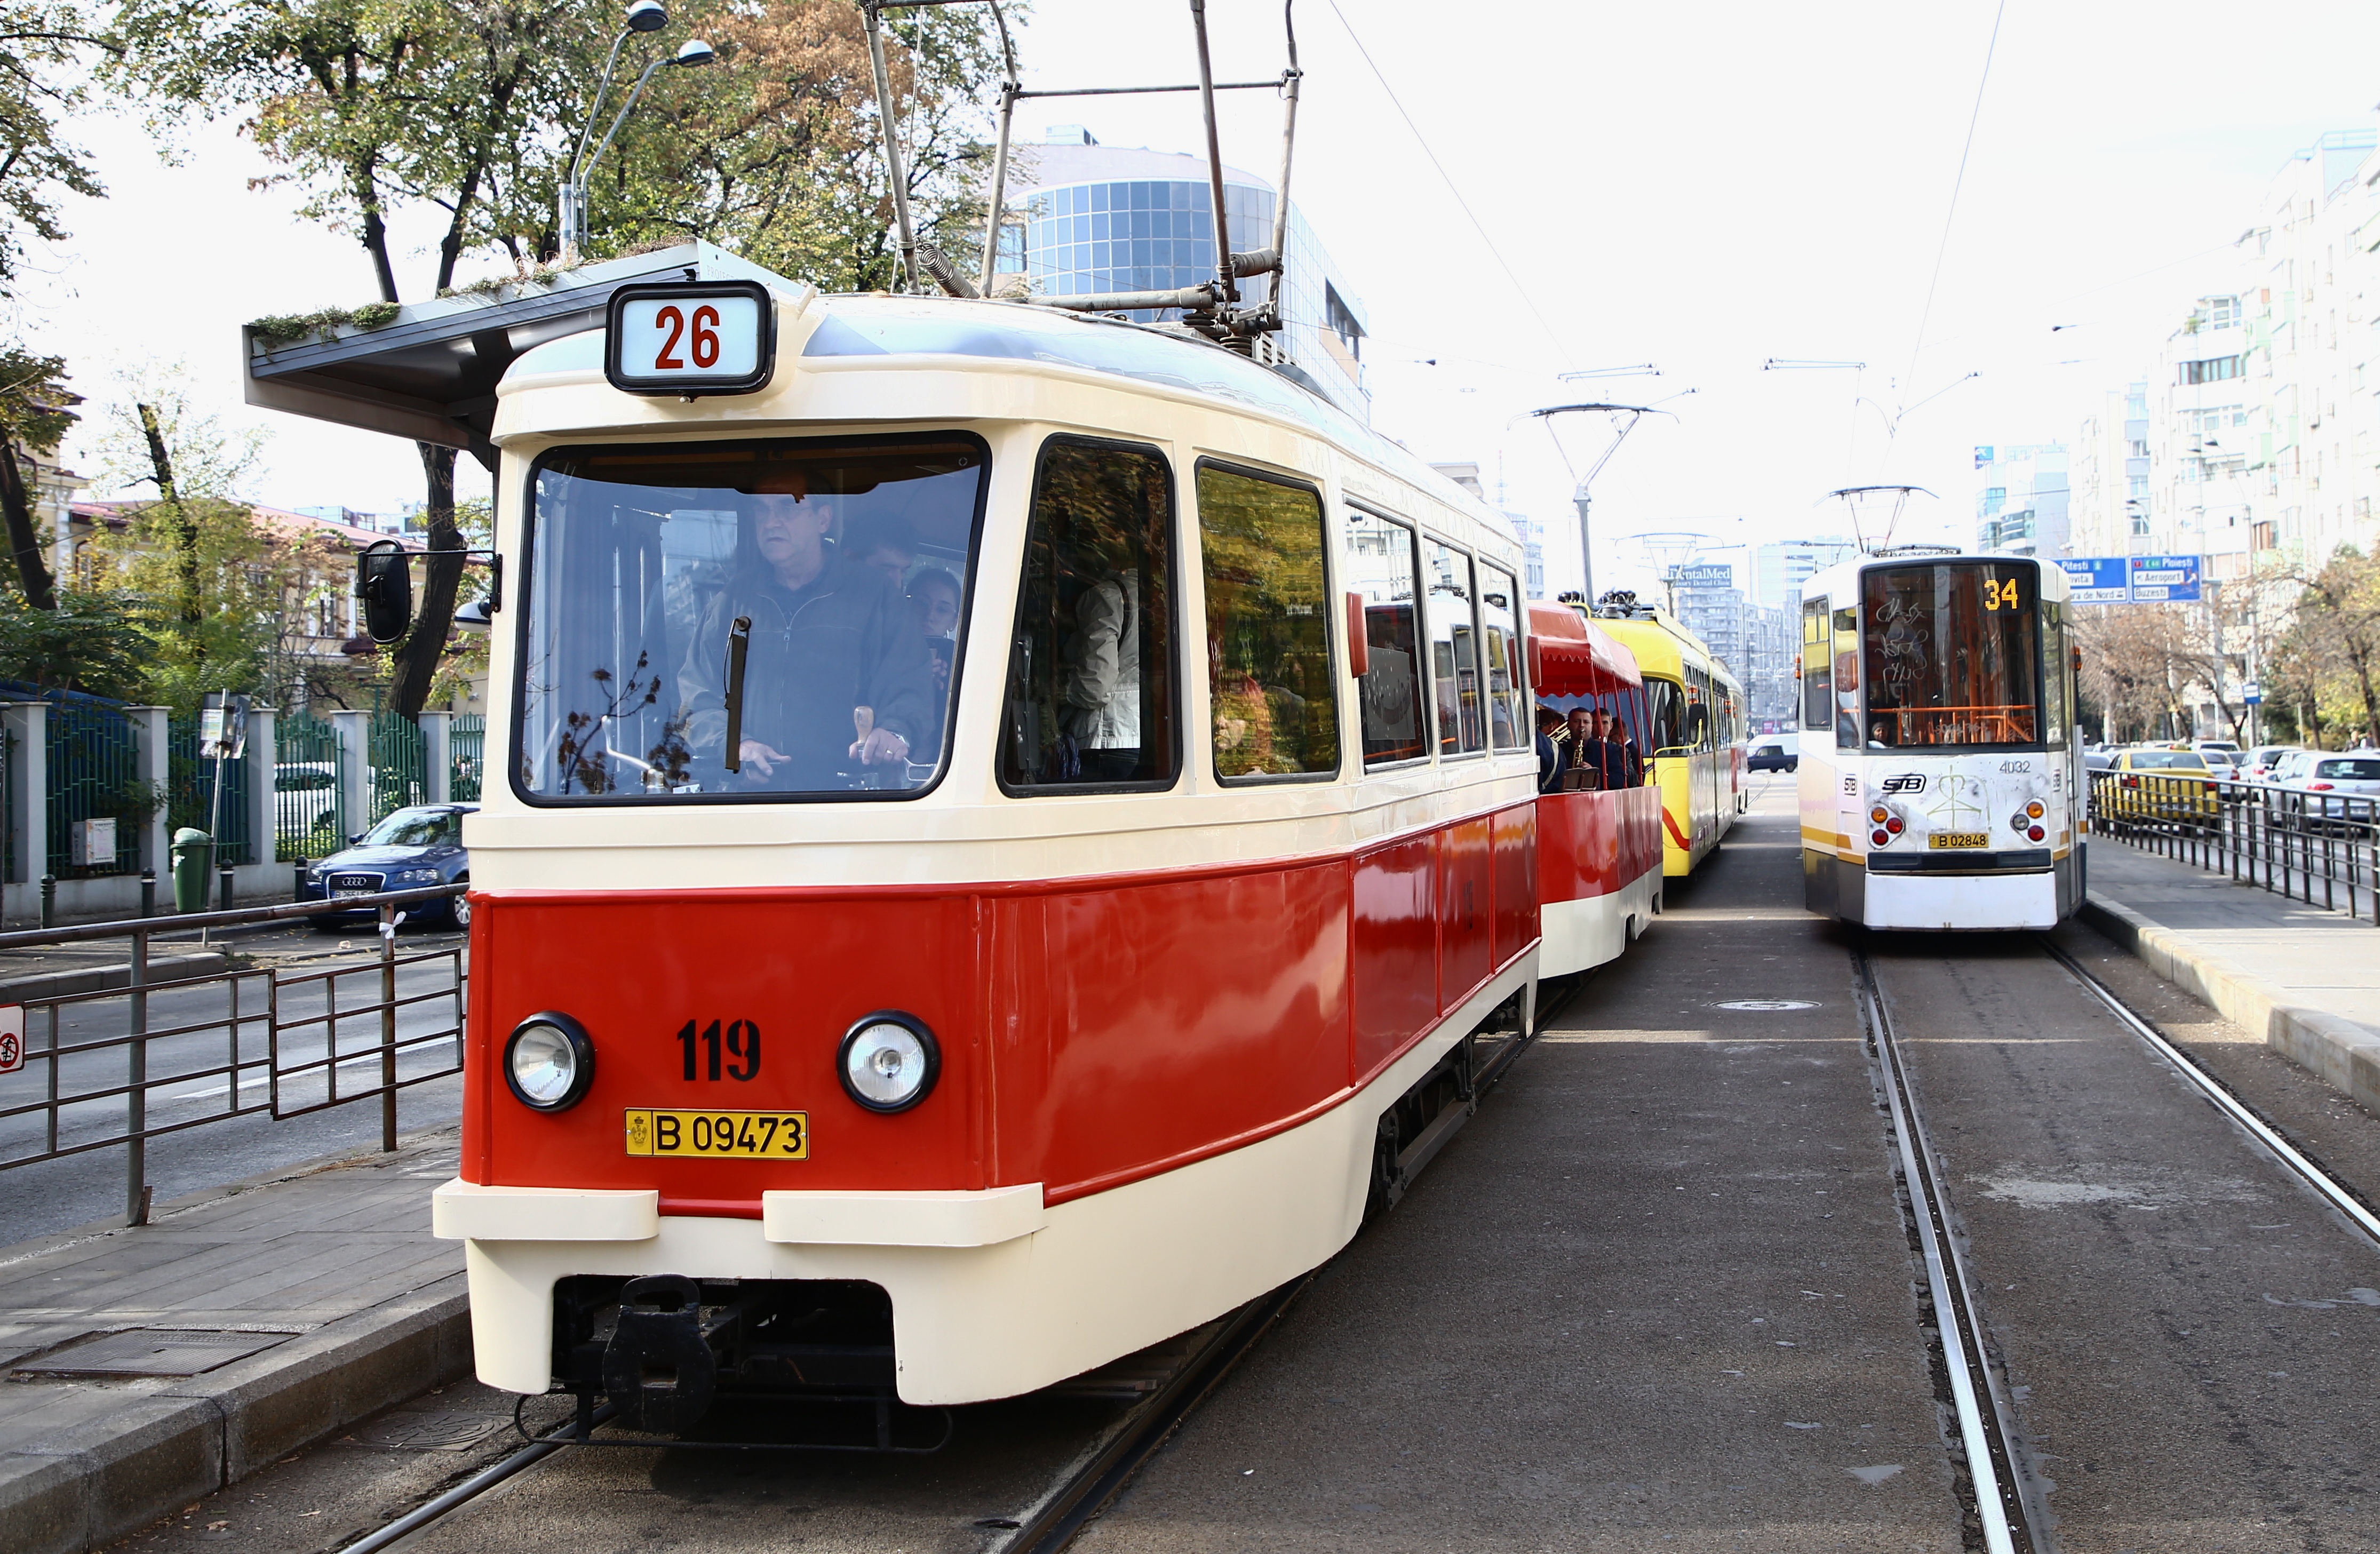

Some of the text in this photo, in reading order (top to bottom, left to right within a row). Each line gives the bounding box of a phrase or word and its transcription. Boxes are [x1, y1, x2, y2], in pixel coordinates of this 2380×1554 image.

[655, 305, 720, 369] 26
[2145, 572, 2180, 584] Aeroport
[1984, 578, 2018, 610] 34
[2083, 591, 2092, 599] de
[2096, 590, 2114, 599] Nord
[1999, 761, 2031, 773] 4032
[1844, 778, 1856, 791] STB
[1882, 778, 1922, 790] STB
[1939, 835, 1986, 847] B 02848
[677, 1019, 761, 1081] 119
[657, 1115, 802, 1153] B 09473
